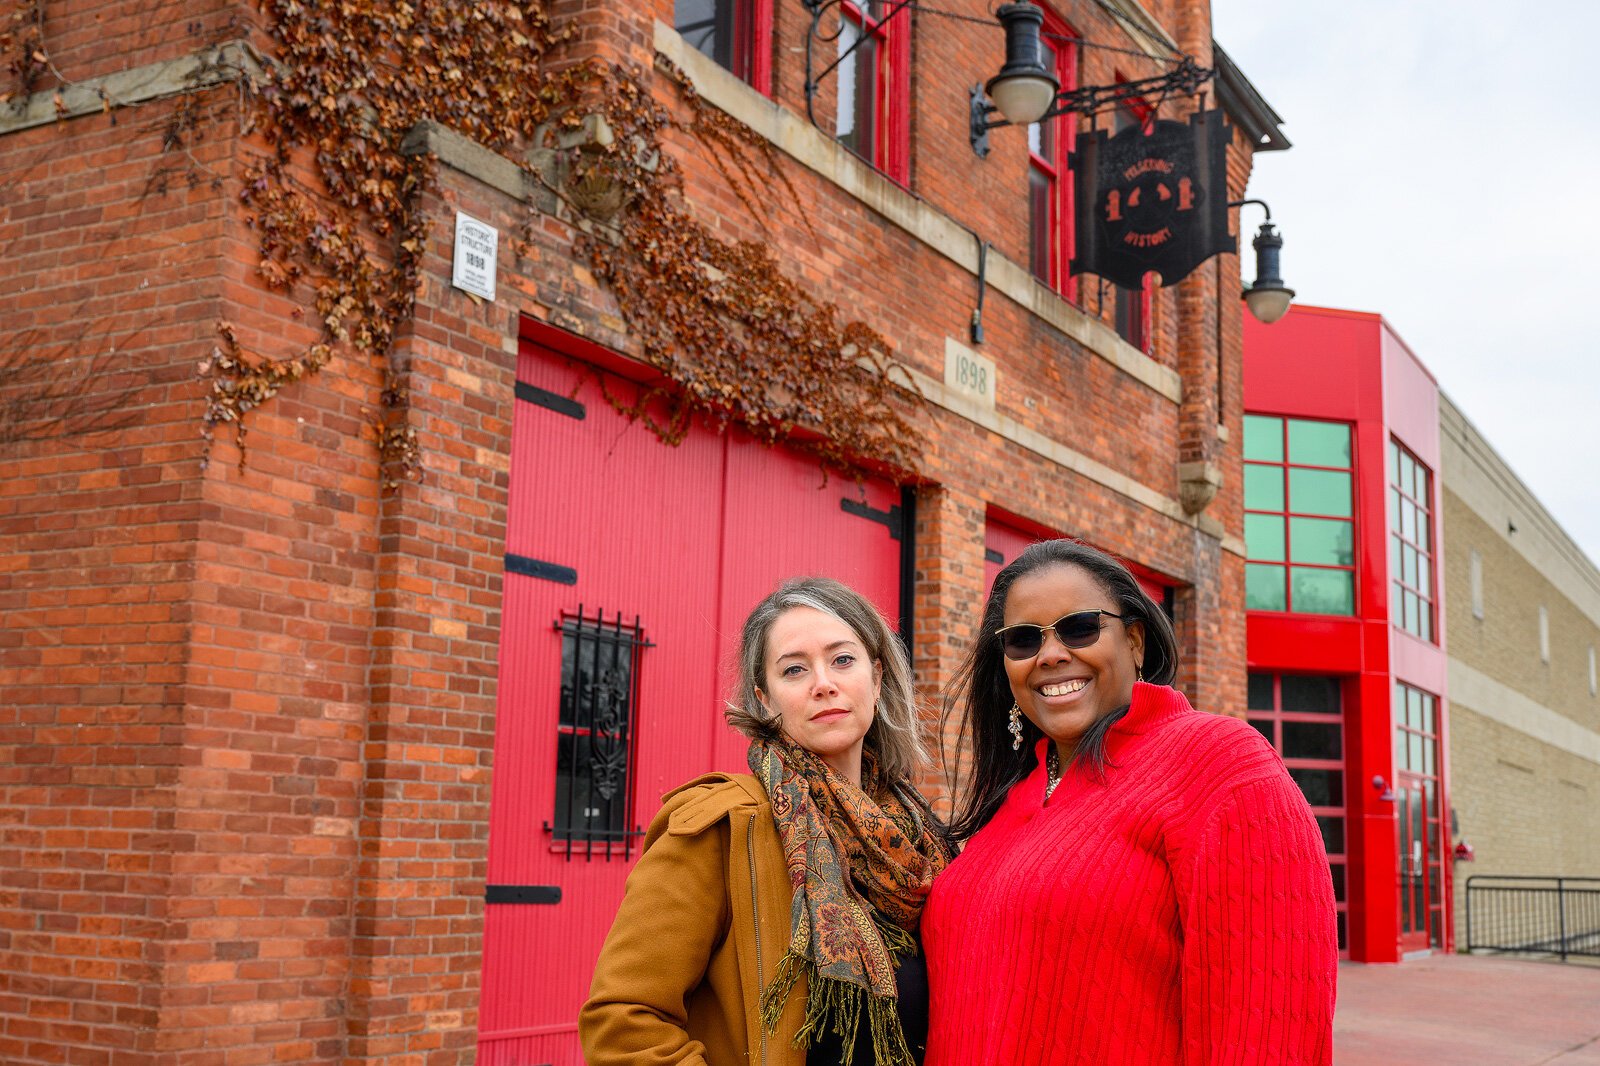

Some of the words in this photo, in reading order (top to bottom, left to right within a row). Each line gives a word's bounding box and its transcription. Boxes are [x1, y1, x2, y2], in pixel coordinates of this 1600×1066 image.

[461, 234, 493, 257] STRUCTURE
[1123, 226, 1173, 247] HISTORY
[956, 354, 987, 395] 1898
